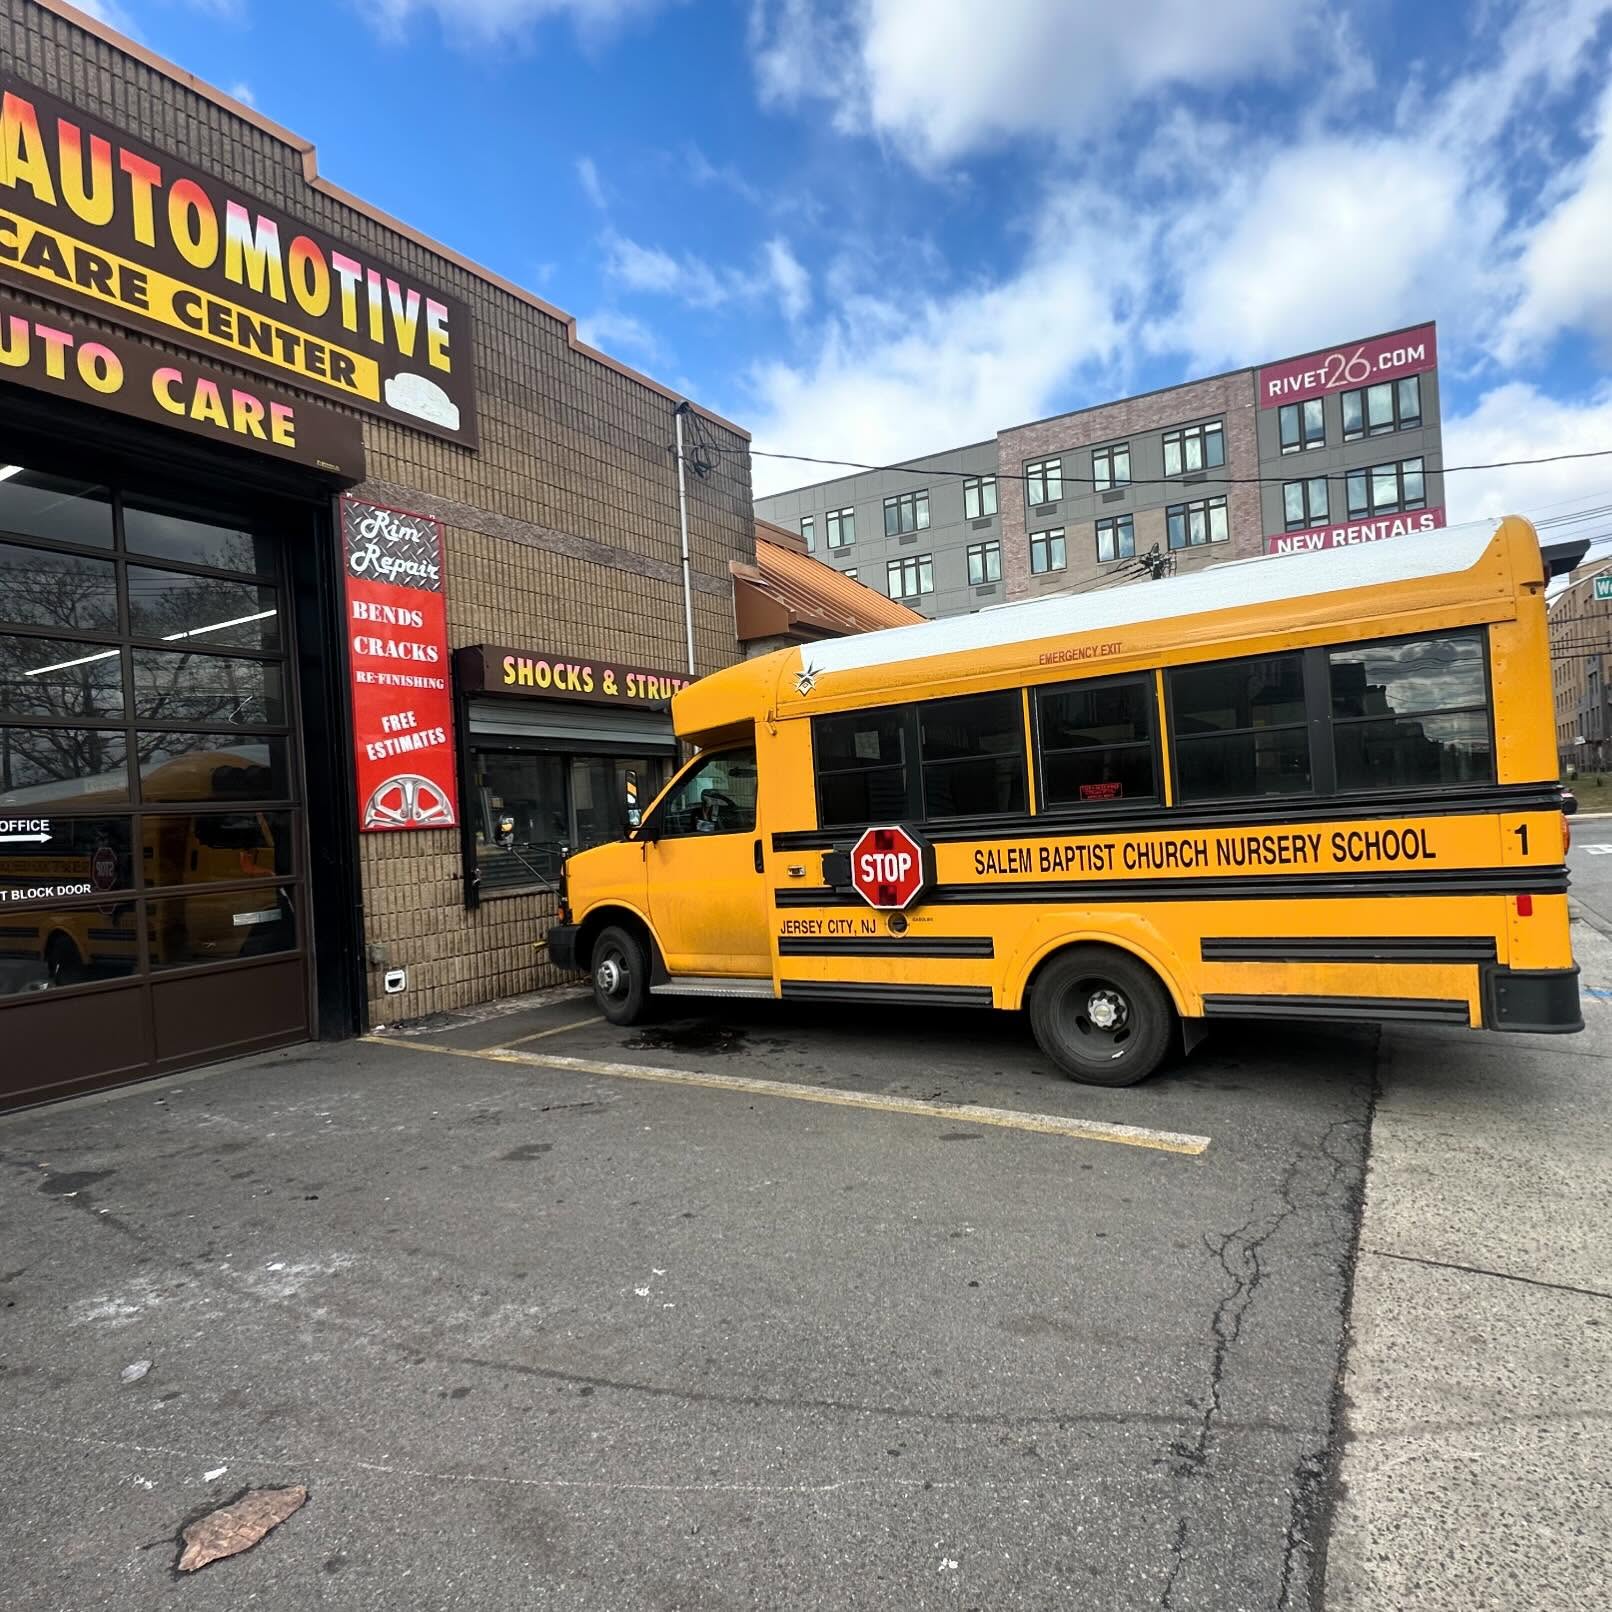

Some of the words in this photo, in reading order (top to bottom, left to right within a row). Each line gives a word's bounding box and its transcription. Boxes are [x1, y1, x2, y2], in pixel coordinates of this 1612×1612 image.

[0, 91, 451, 374] AUTOMOTIVE
[172, 289, 359, 390] CENTER
[152, 367, 296, 448] CARE
[360, 510, 421, 543] Rim
[1277, 532, 1325, 554] NEW
[1332, 513, 1435, 548] RENTALS
[350, 543, 440, 582] Repair
[352, 600, 424, 628] BENDS
[353, 636, 440, 663] CRACKS
[1039, 645, 1099, 666] EMERGENCY
[1100, 642, 1122, 656] EXIT
[503, 655, 595, 693] SHOCKS
[602, 669, 619, 696] &
[381, 710, 418, 734] FREE
[366, 727, 447, 762] ESTIMATES
[0, 819, 51, 832] OFFICE
[1514, 824, 1529, 856] 1
[860, 852, 912, 883] STOP
[974, 848, 1033, 875] SALEM
[1039, 843, 1116, 873] BAPTIST
[1122, 839, 1209, 871] CHURCH
[1216, 833, 1322, 866] NURSERY
[1331, 828, 1437, 863] SCHOOL
[11, 887, 54, 900] BLOCK
[57, 884, 91, 896] DOOR
[780, 919, 823, 935] JERSEY
[827, 918, 857, 937] CITY,
[861, 918, 877, 934] NJ
